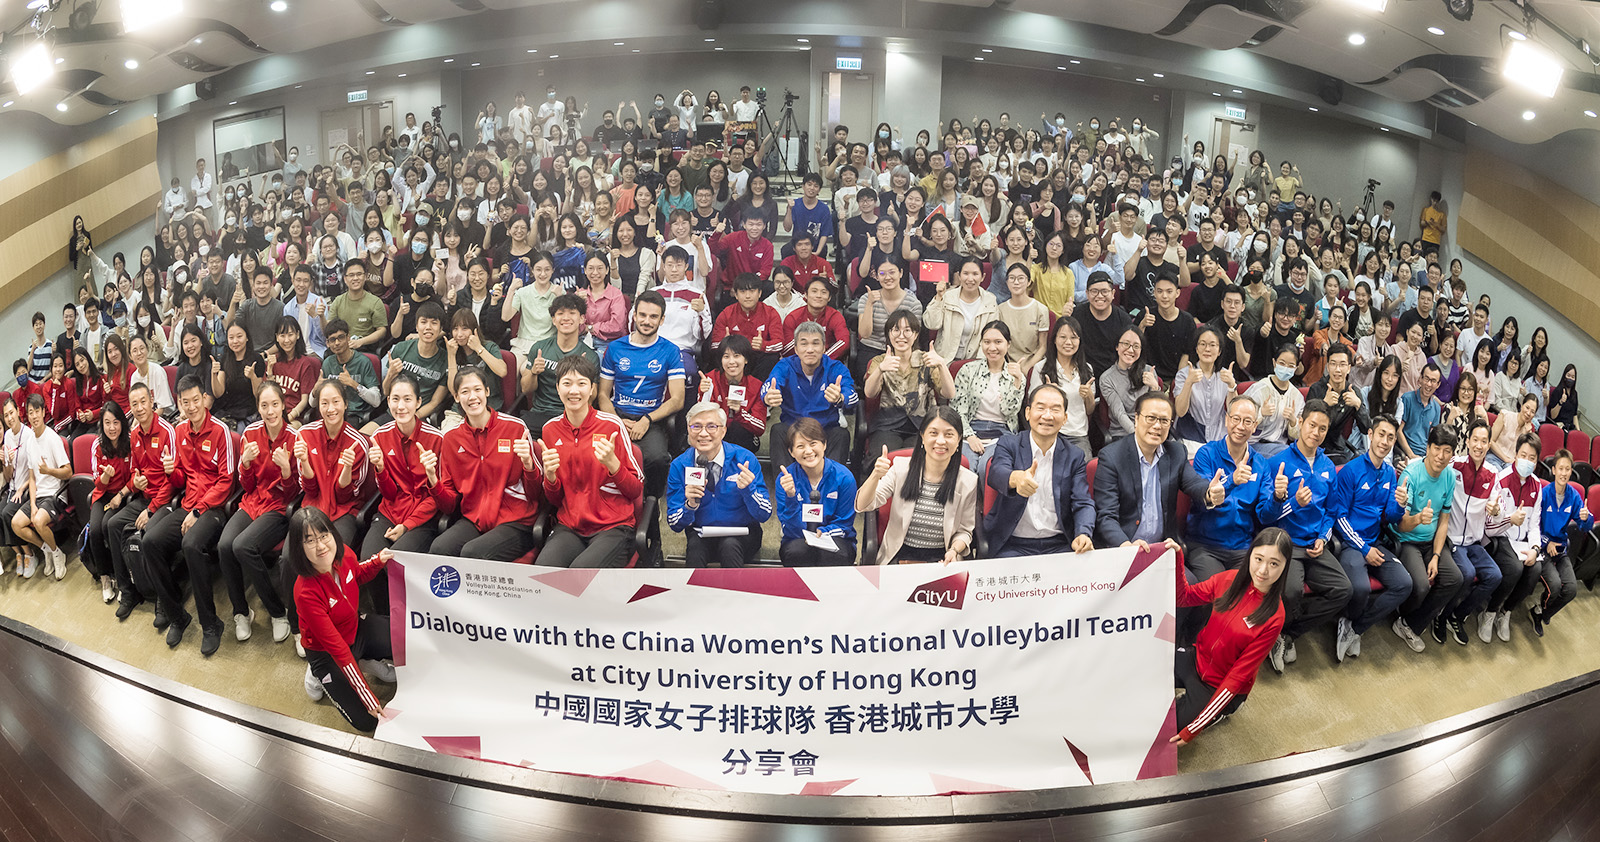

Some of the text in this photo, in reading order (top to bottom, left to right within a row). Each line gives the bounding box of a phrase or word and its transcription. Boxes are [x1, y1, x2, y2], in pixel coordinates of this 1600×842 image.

[632, 375, 646, 393] 7
[466, 581, 496, 590] Volleyball
[497, 585, 533, 594] Association
[975, 573, 1041, 587] 香港城市大學
[467, 588, 482, 596] Hong
[503, 590, 521, 598] China
[914, 590, 958, 606] CityU
[975, 582, 1115, 602] City University of Hong Kong
[410, 610, 507, 642] Dialogue
[513, 624, 567, 647] with
[574, 627, 616, 650] the
[622, 630, 695, 653] China
[831, 629, 946, 654] National
[952, 618, 1080, 650] Volleyball
[1086, 612, 1153, 636] Team
[570, 664, 977, 697] at City University of Hong Kong
[535, 690, 1020, 735] 中國國家女子排球隊 香港城市大學
[721, 748, 820, 777] 分享會
